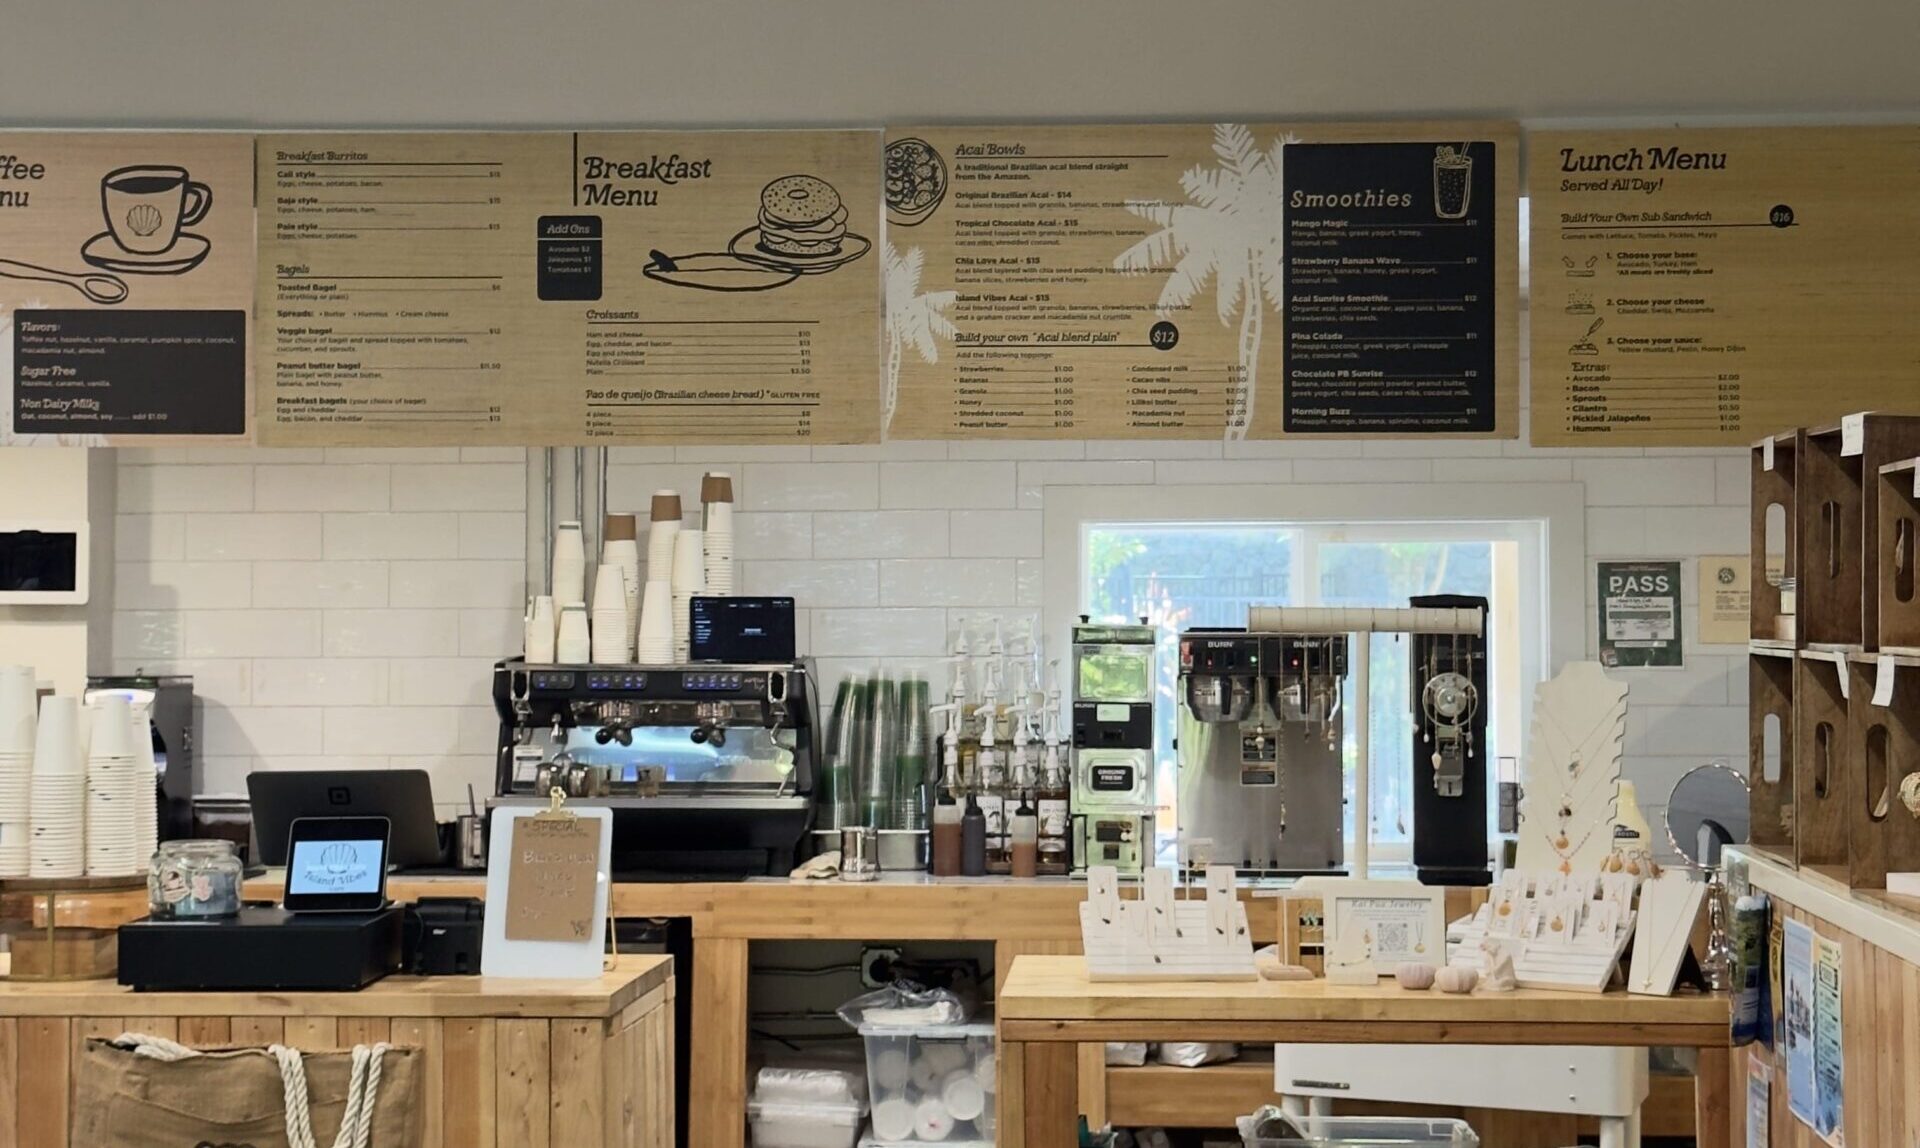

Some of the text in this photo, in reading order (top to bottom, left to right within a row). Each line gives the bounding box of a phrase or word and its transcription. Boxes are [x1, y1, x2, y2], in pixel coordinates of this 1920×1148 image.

[955, 143, 1026, 155] Acai Bowls
[276, 151, 368, 164] Breakfast Burritos
[1560, 147, 1726, 172] Lunch Menu
[583, 155, 712, 185] Breakfast
[1095, 163, 1129, 171] straight
[295, 171, 316, 179] style
[1560, 178, 1664, 194] Served All Day!
[582, 183, 658, 206] Menu
[955, 192, 989, 200] Original
[991, 191, 1028, 199] Brazilian
[1057, 191, 1072, 199] $14
[1290, 190, 1412, 208] Smoothies
[298, 197, 318, 205] style
[1561, 211, 1712, 223] Build Your Own Sub Sandwich
[297, 223, 318, 231] style
[955, 220, 990, 228] Tropical
[1291, 220, 1321, 228] Mango
[1323, 220, 1348, 228] Magic
[547, 224, 590, 234] Add Ons
[955, 257, 974, 265] Chia
[1652, 253, 1672, 262] your
[276, 264, 311, 278] Bagels
[312, 284, 337, 292] Bagel
[956, 294, 981, 302] Island
[1651, 299, 1672, 307] your
[586, 309, 639, 319] Croissants
[954, 333, 982, 344] Build
[981, 335, 1007, 346] your
[1007, 334, 1029, 342] own
[1061, 331, 1092, 342] blend
[1153, 330, 1175, 343] $12
[1312, 332, 1343, 340] Colada
[1616, 337, 1650, 345] Choose
[337, 362, 361, 370] bagel
[21, 365, 76, 378] Sugar Free
[1291, 370, 1336, 378] Chocolate
[586, 389, 604, 399] Pao
[605, 389, 619, 399] de
[621, 390, 653, 401] queijo
[698, 390, 731, 399] cheese
[20, 398, 41, 408] Non
[42, 398, 72, 412] Dairy
[319, 397, 347, 405] bagels
[1292, 408, 1328, 416] Morning
[1607, 415, 1651, 423] Jalapeños
[1609, 576, 1669, 592] PASS
